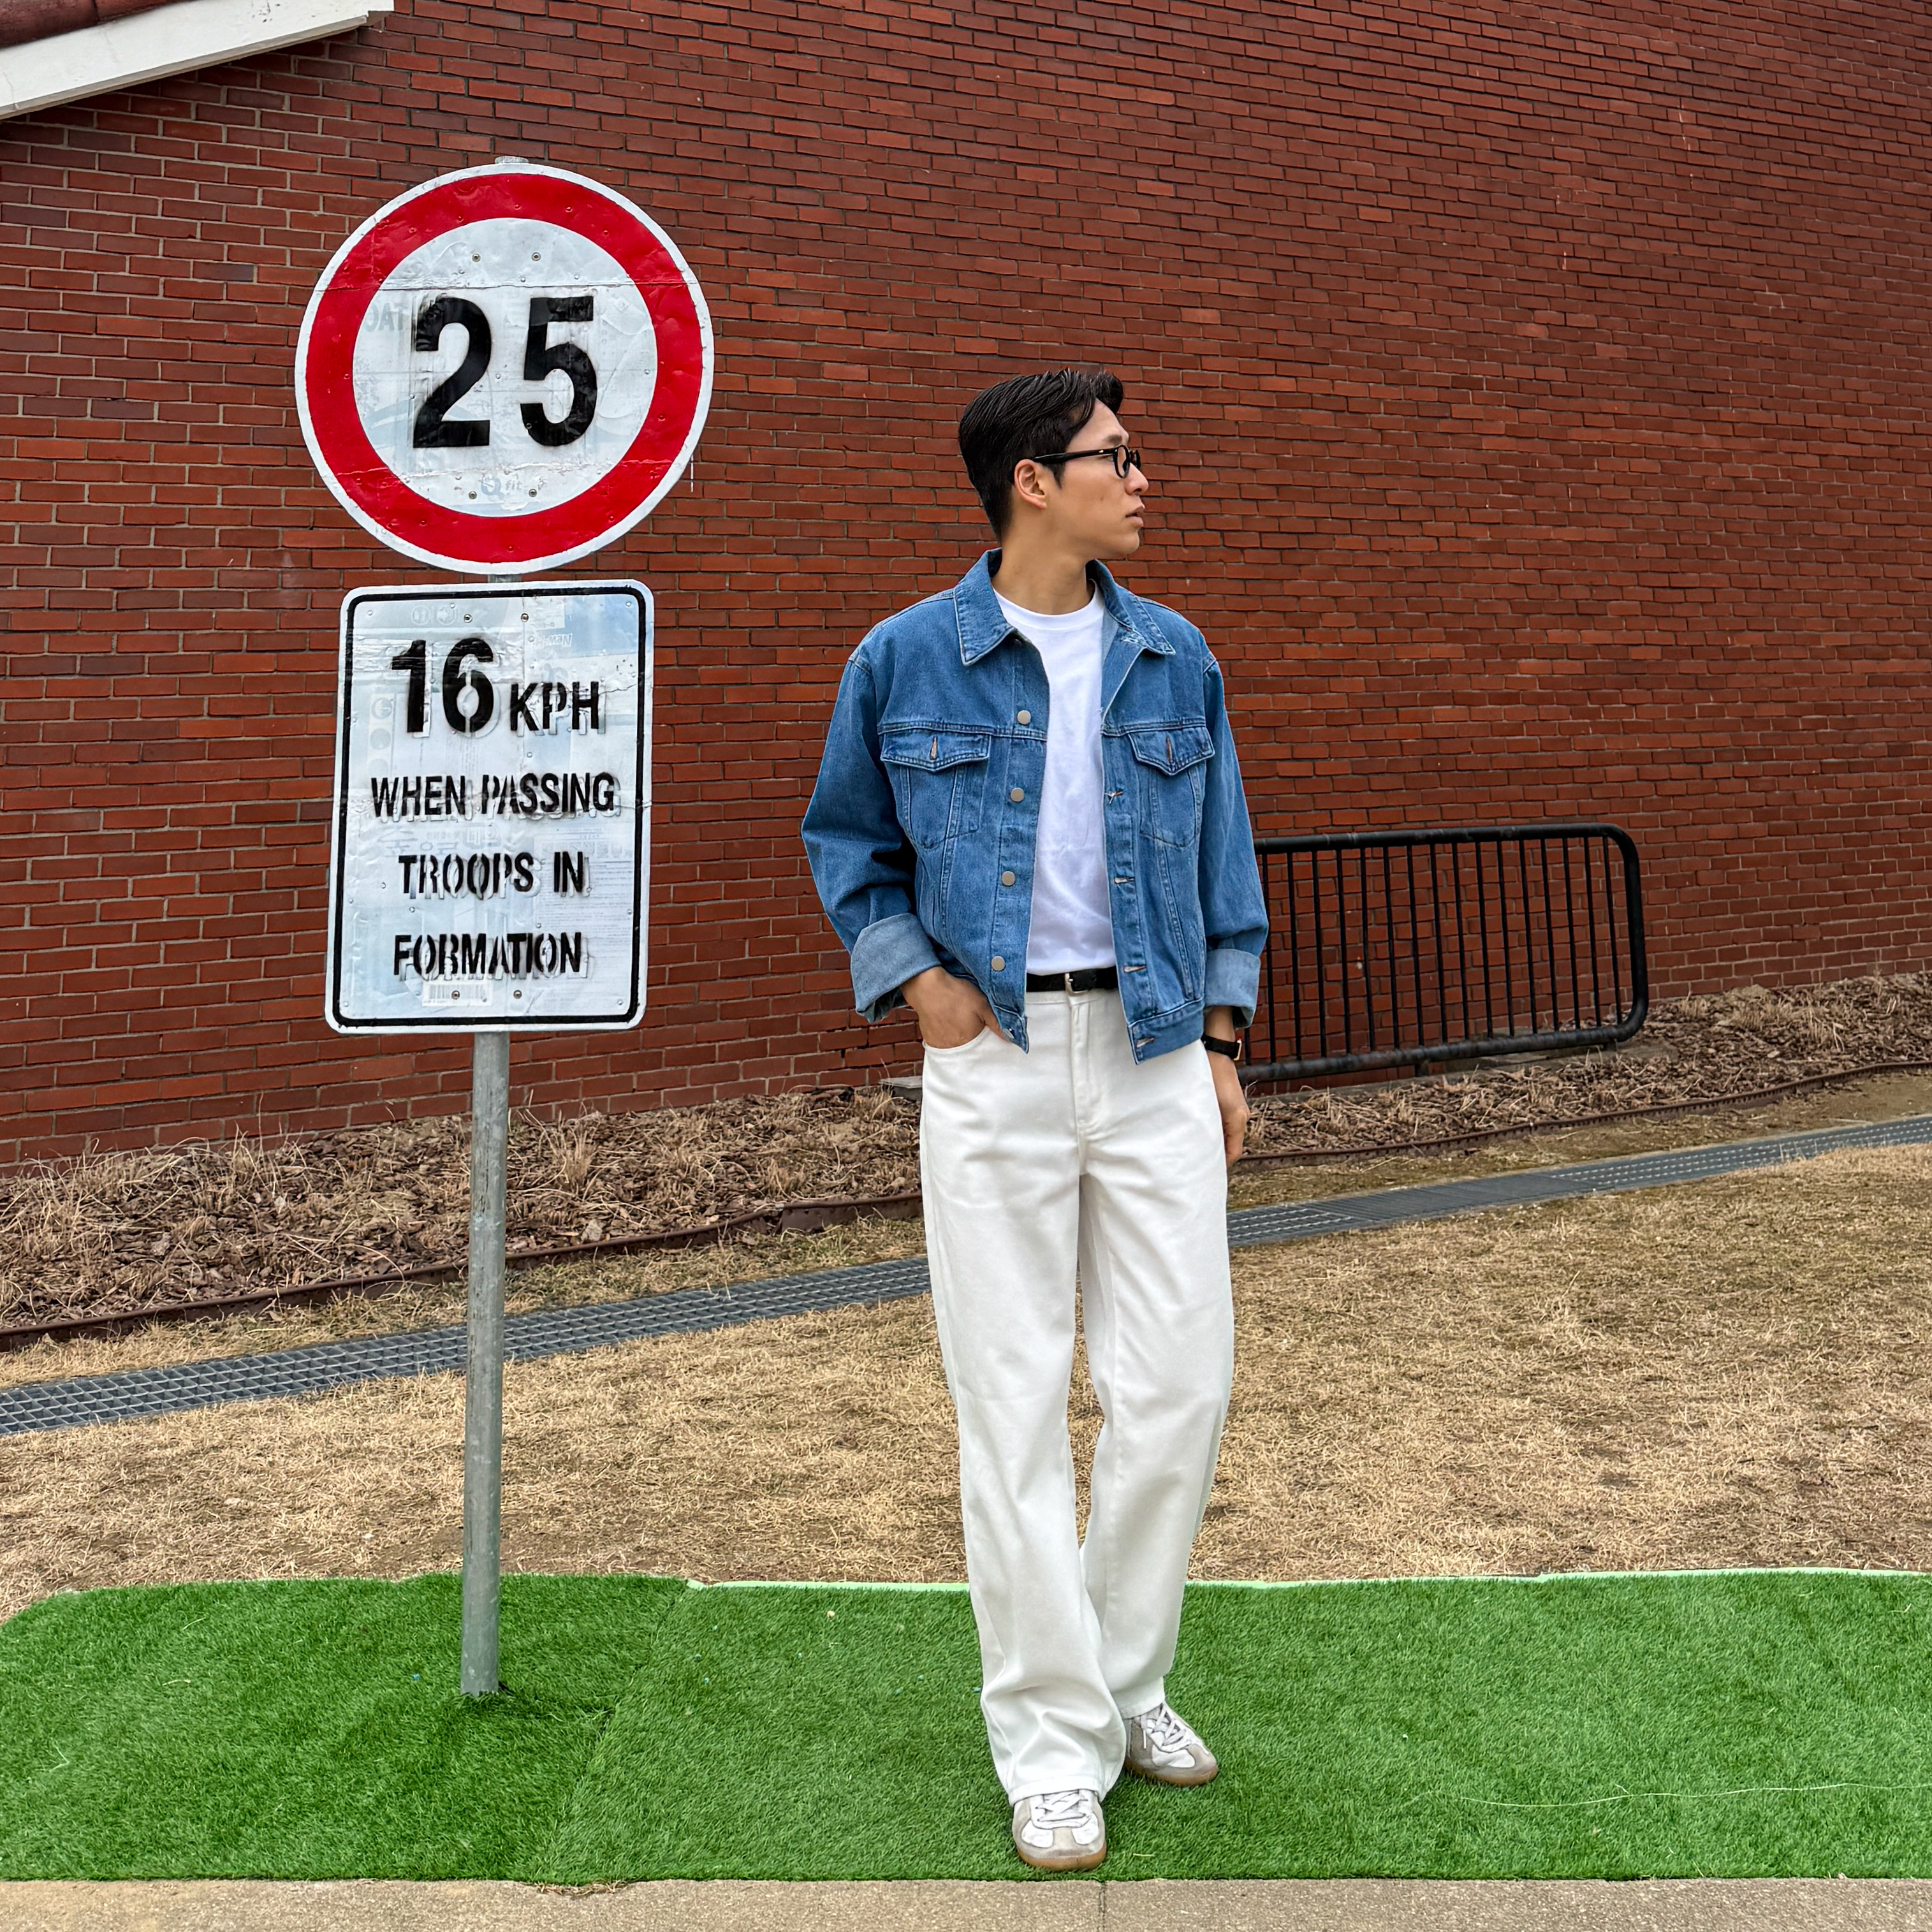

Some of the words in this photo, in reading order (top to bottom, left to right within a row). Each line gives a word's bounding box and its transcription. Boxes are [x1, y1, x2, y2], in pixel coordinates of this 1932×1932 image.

[412, 296, 597, 448] 25
[392, 638, 494, 733] 16
[509, 681, 599, 731] KPH
[372, 775, 465, 817] WHEN
[481, 773, 615, 816] PASSING
[399, 852, 534, 896] TROOPS
[553, 851, 584, 893] IN
[394, 932, 582, 976] FORMATION
